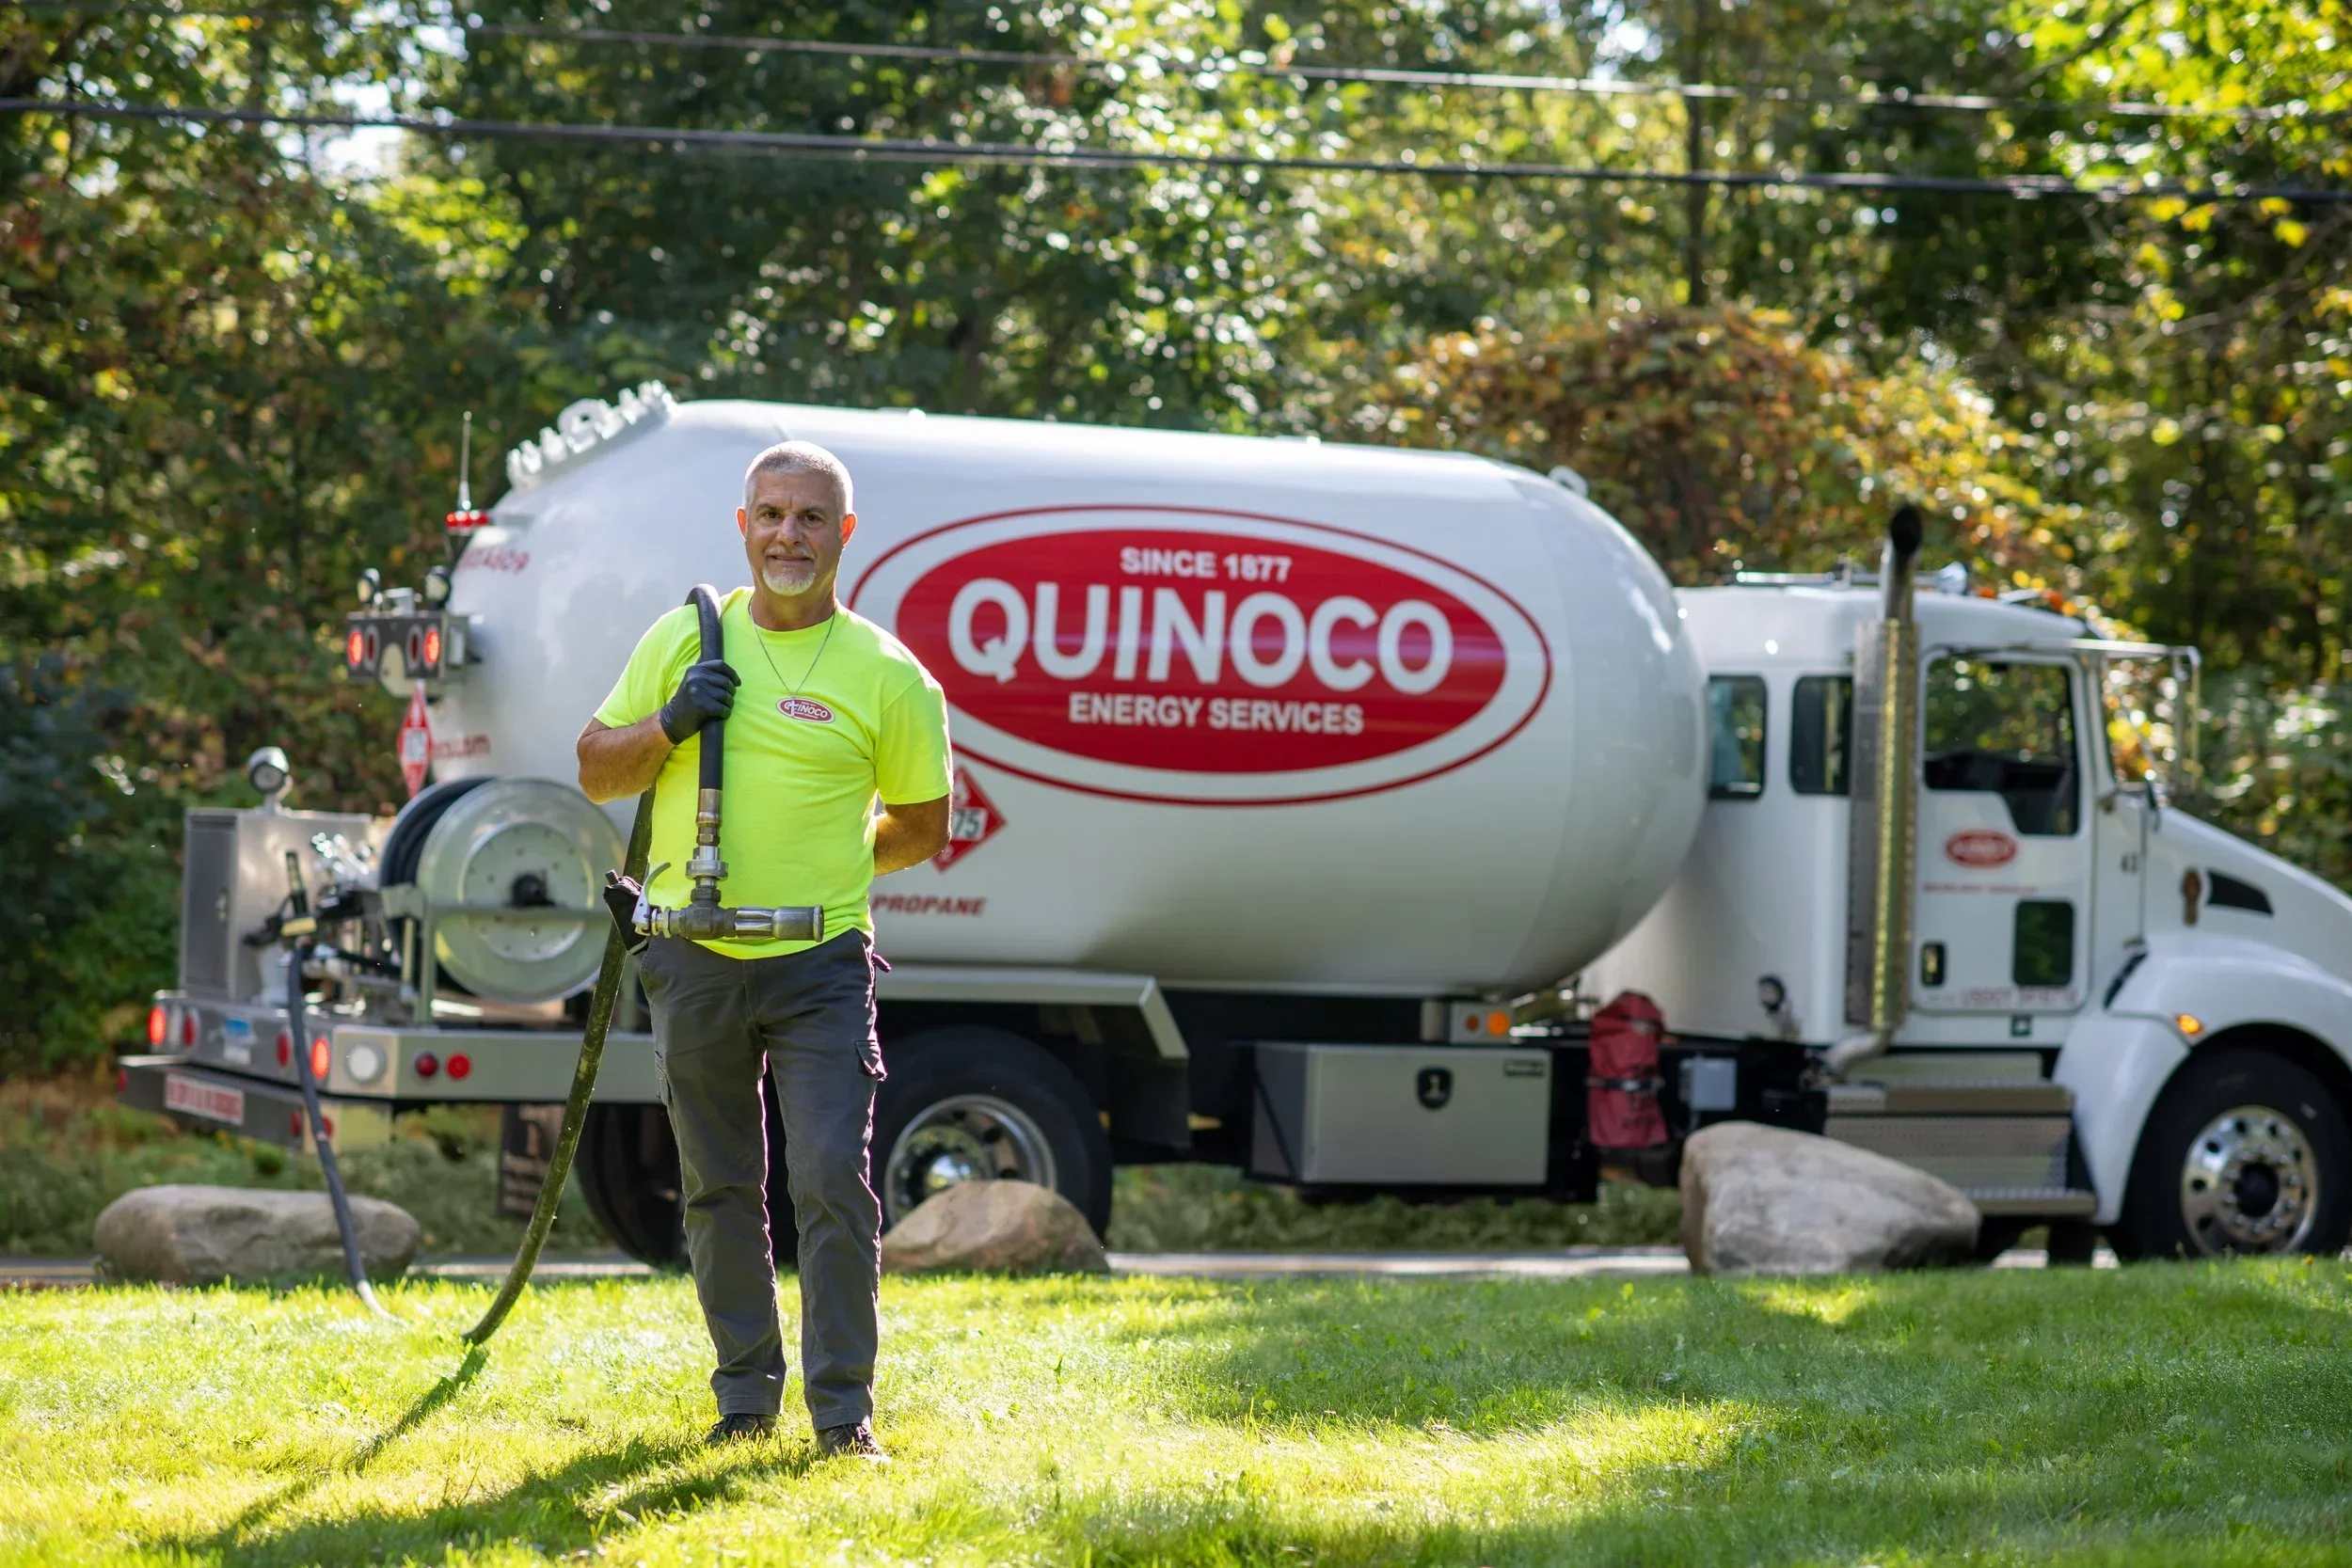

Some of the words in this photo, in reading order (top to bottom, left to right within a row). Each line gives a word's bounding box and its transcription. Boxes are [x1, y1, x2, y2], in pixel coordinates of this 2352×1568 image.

[1120, 547, 1216, 578] SINCE
[1224, 553, 1292, 581] 1877
[948, 578, 1454, 694] QUINOCO
[784, 701, 828, 718] QINOCO
[1069, 693, 1202, 727] ENERGY
[1209, 701, 1363, 734] SERVICES
[951, 810, 980, 838] 75
[871, 894, 986, 916] PROPANE
